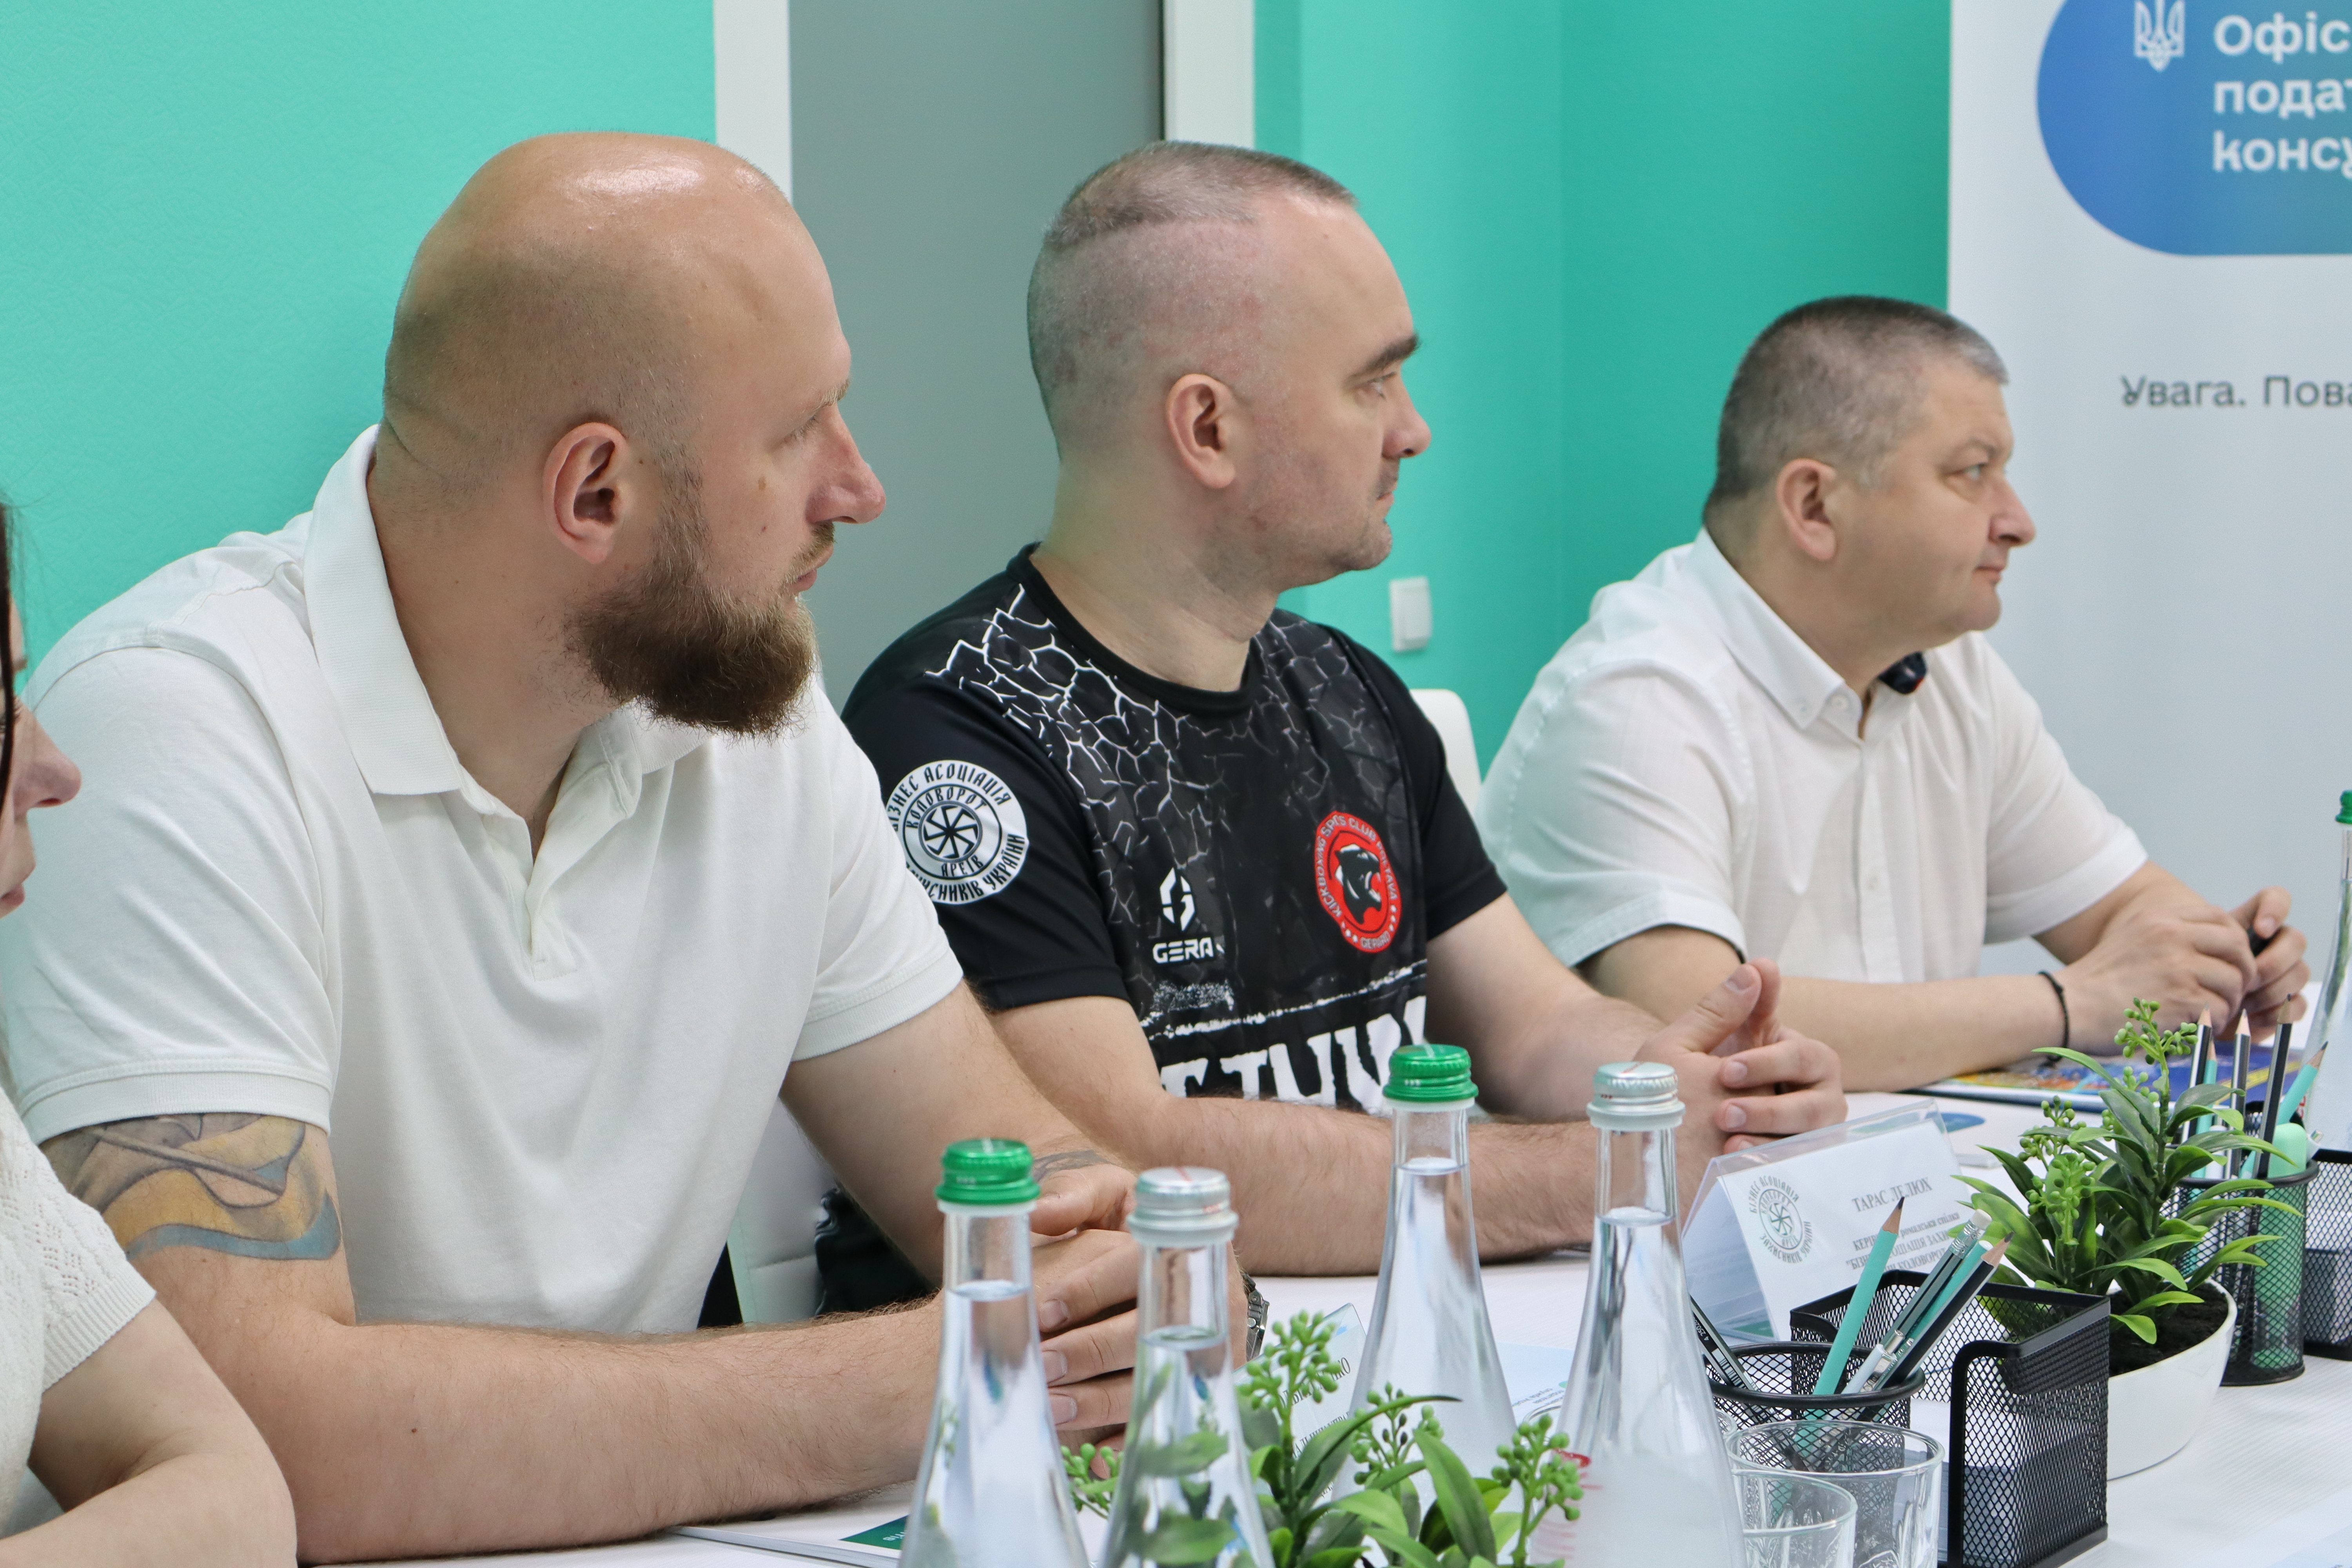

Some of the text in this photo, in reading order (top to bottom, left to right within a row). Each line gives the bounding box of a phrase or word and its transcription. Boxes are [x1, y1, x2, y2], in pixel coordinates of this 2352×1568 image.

[2214, 11, 2350, 64] Офіс
[2120, 375, 2352, 407] Увага. Пов
[924, 763, 1011, 805] АСОЦІАЦІЯ
[906, 786, 987, 829] КОЛОВОРОТ
[1348, 817, 1376, 841] CLUB
[982, 833, 1025, 890] УКРАЇНИ
[1152, 937, 1214, 964] GERA
[1851, 1190, 1889, 1212] ТАРАС
[1900, 1220, 1937, 1239] ромадська
